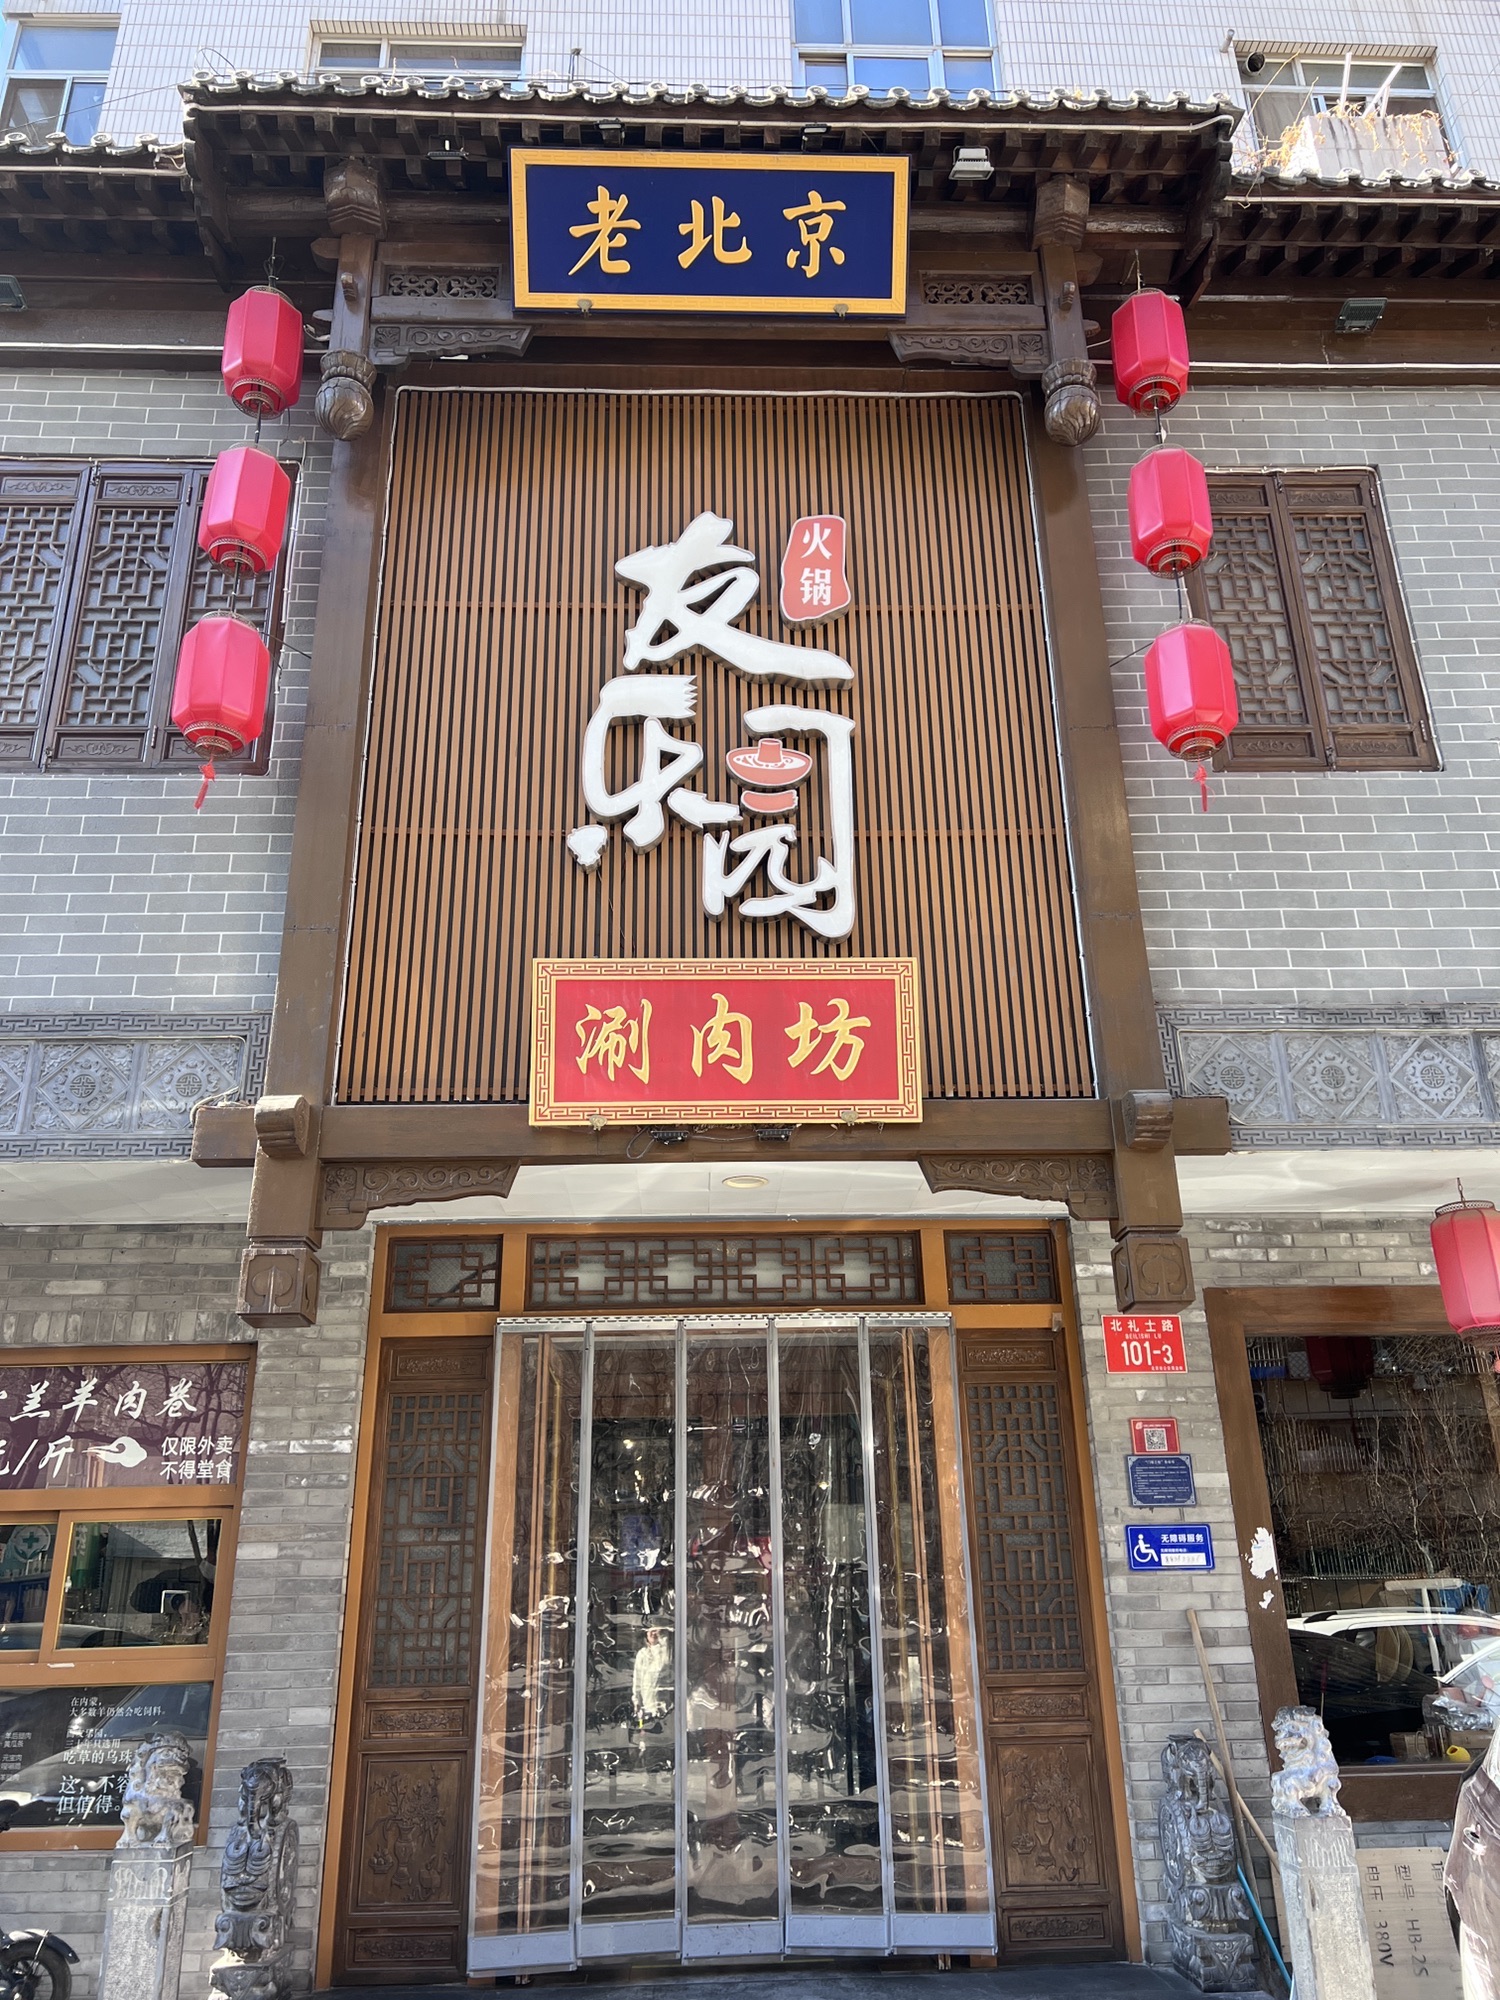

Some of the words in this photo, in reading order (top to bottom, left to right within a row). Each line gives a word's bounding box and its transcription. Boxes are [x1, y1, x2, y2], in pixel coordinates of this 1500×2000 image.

[569, 185, 847, 277] 老北京
[799, 534, 834, 606] 火锅
[569, 511, 855, 941] 友乐园
[574, 992, 872, 1084] 涮肉坊
[1110, 1319, 1174, 1332] 北礼士路
[1121, 1341, 1173, 1366] 101-3
[0, 1377, 198, 1422] 羔羊肉卷
[161, 1436, 233, 1454] 仅限外卖
[160, 1460, 232, 1479] 不得堂食
[1160, 1533, 1204, 1543] 无障碍服务
[63, 1750, 135, 1765] 吃草的乌珠
[57, 1795, 121, 1815] 但值得。
